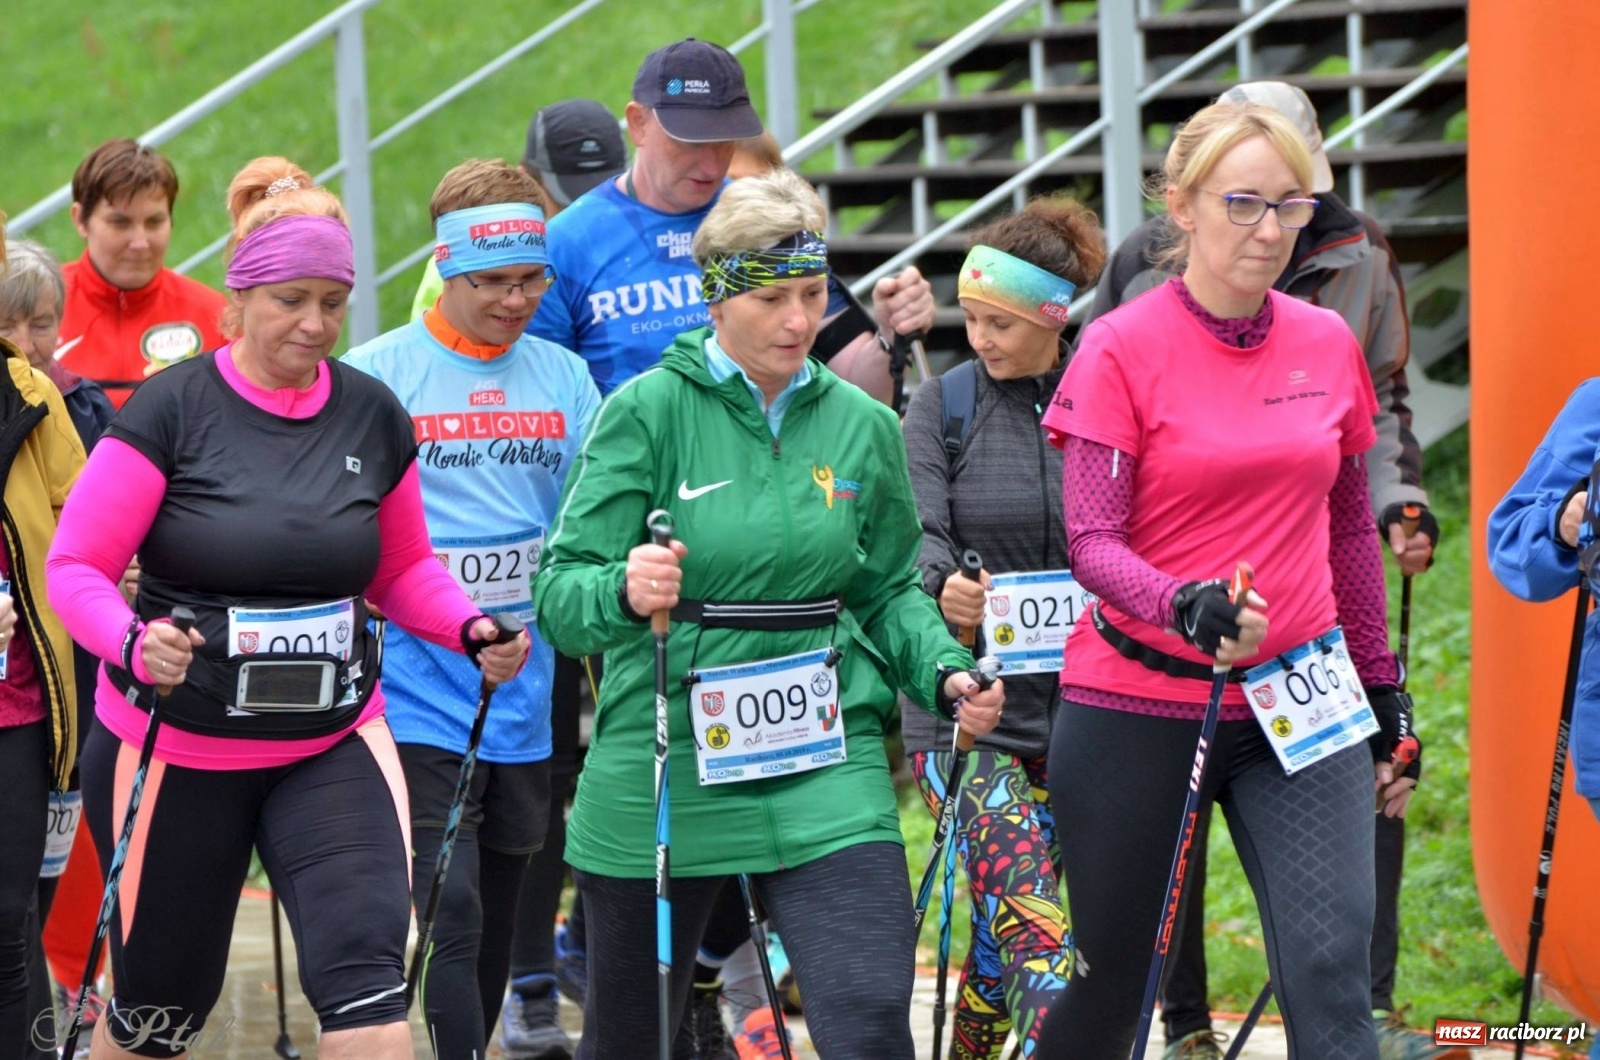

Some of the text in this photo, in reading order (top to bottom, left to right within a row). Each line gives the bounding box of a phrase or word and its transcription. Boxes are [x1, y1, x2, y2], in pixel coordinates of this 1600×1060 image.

[473, 392, 504, 404] HERO
[475, 379, 498, 390] JUST
[420, 416, 559, 437] I LOVE
[417, 437, 563, 474] Nordic Walking
[461, 550, 521, 584] 022
[1020, 595, 1075, 629] 021
[1285, 656, 1340, 705] 006
[736, 685, 807, 729] 009
[1189, 734, 1208, 792] LEKI
